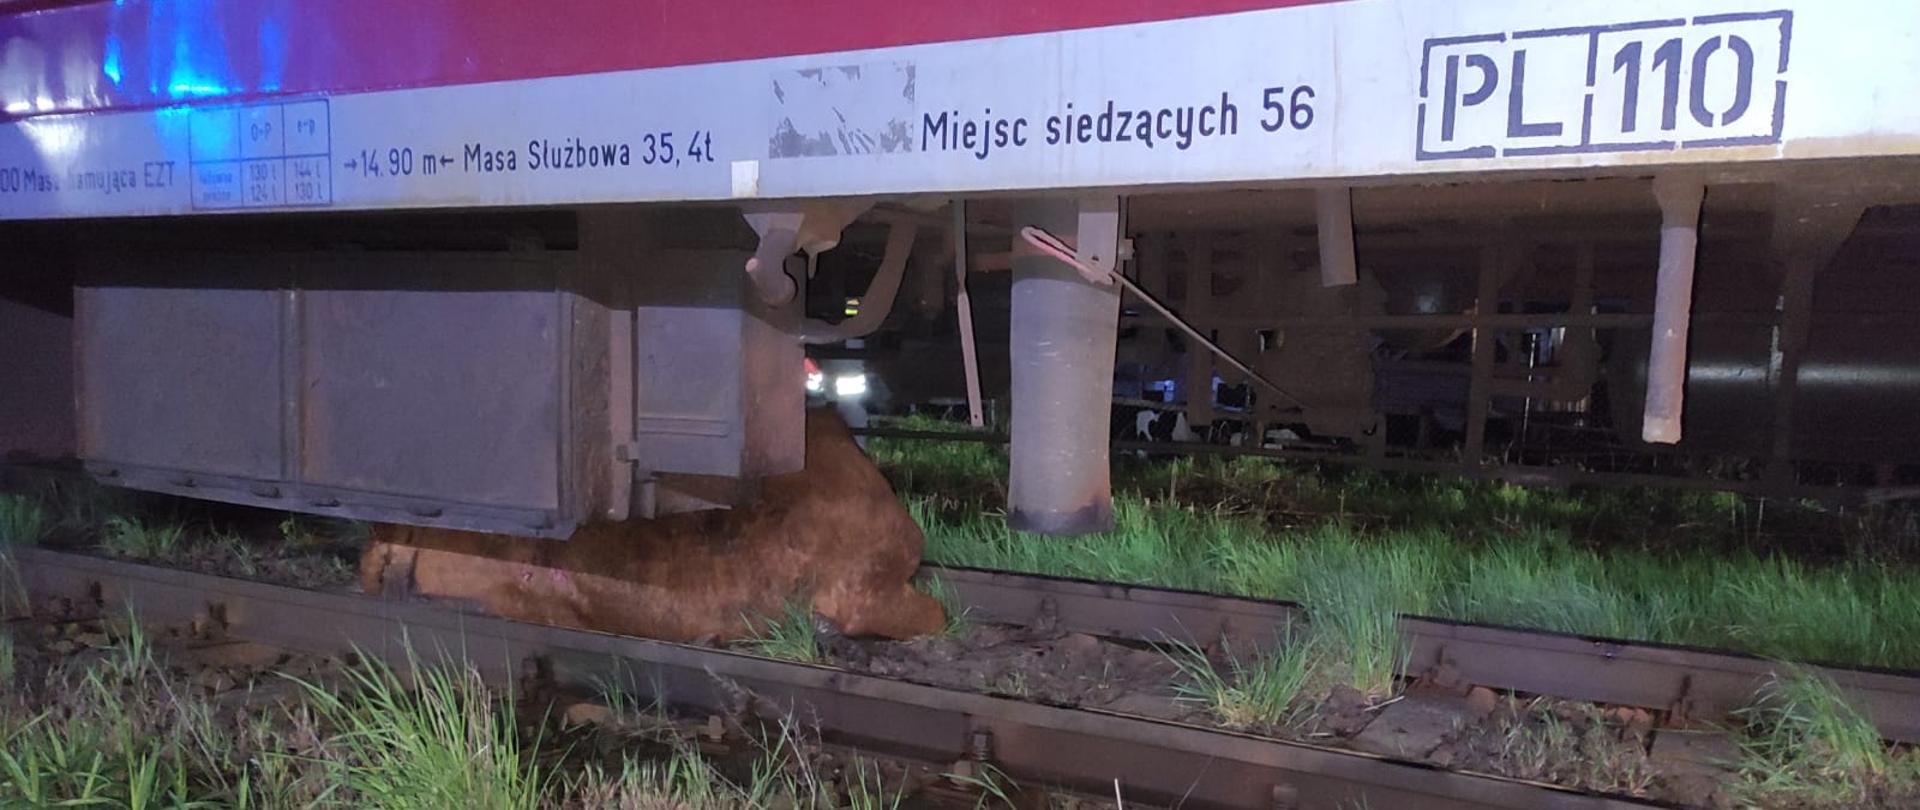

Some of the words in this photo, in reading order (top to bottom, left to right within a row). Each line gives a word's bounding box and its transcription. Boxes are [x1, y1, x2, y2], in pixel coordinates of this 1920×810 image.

[1441, 49, 1564, 142] PL
[1612, 34, 1755, 133] 110
[921, 108, 1028, 160] Miejsc
[1045, 91, 1239, 150] siedzących
[1259, 84, 1316, 133] 56
[143, 160, 176, 188] EZT
[422, 153, 437, 175] m
[463, 143, 517, 173] Masa
[527, 136, 631, 169] Służbowa
